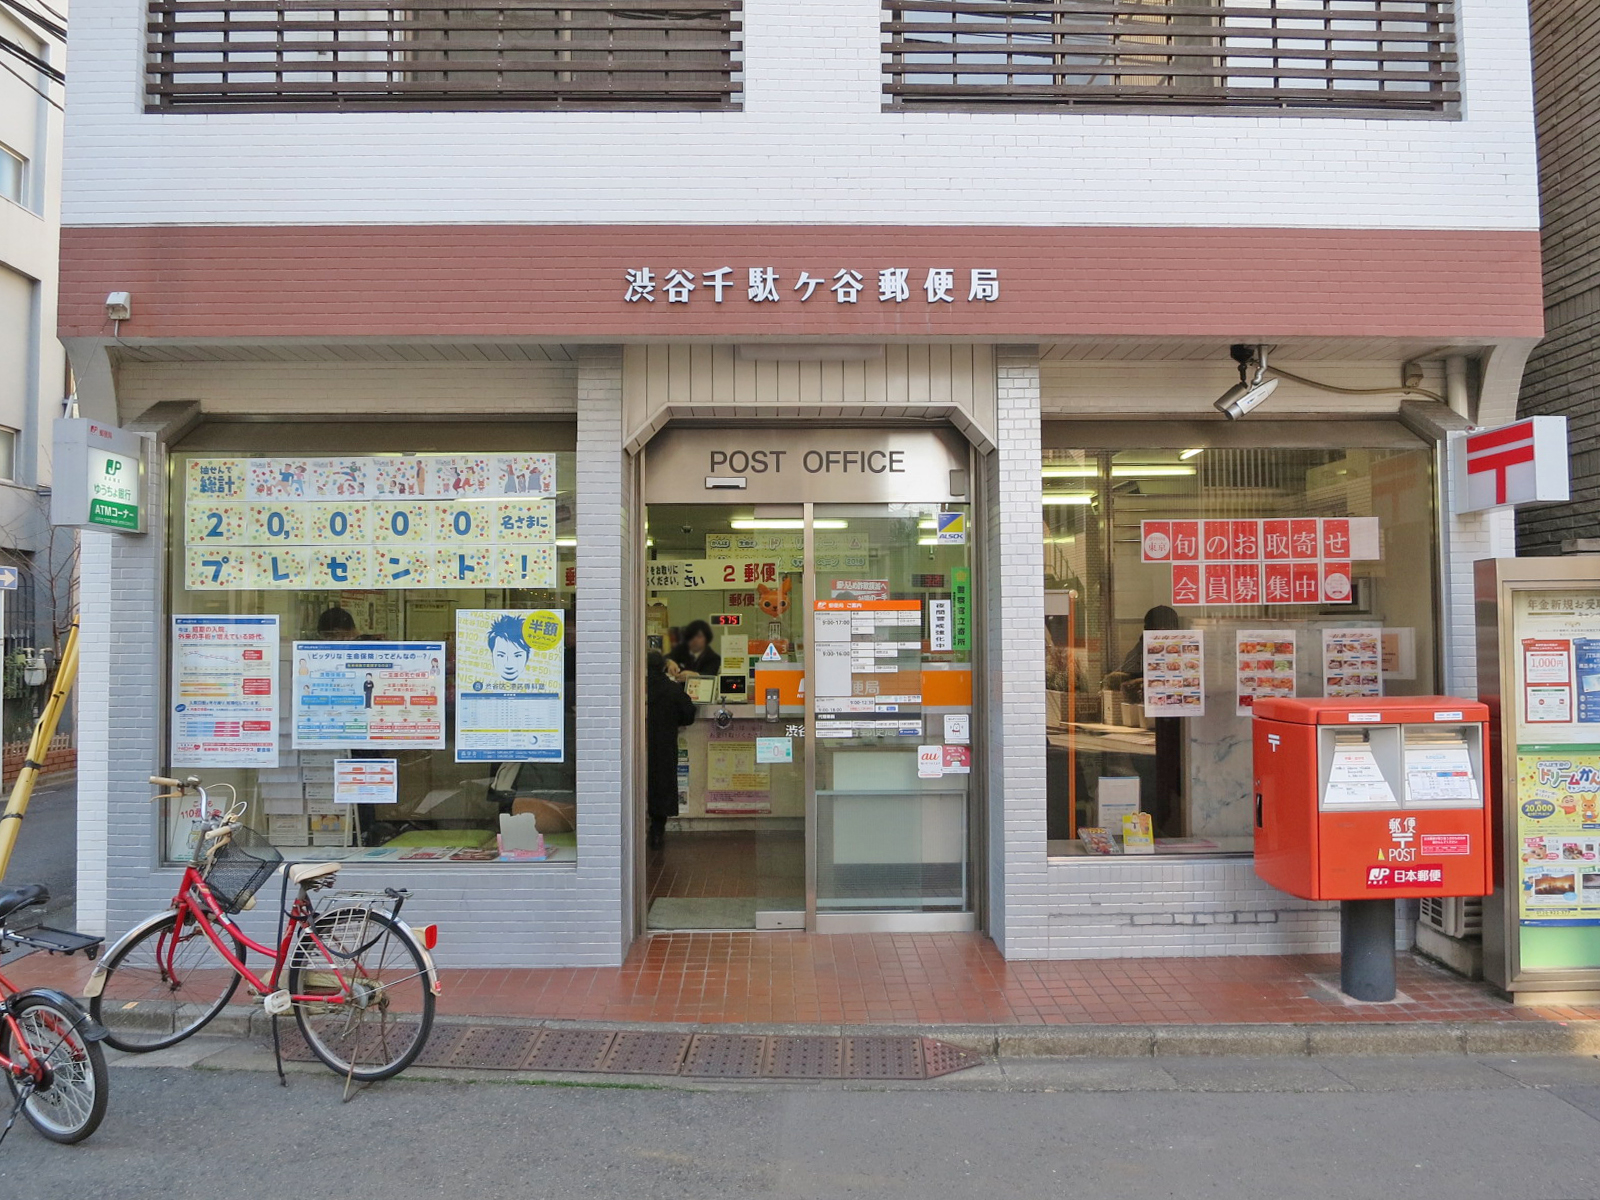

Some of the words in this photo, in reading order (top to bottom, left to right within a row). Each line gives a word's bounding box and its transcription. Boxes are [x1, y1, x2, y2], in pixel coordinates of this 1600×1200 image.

[710, 450, 787, 473] POST
[803, 450, 905, 473] OFFICE
[200, 476, 235, 493] 総計
[94, 484, 131, 501] ゆうちょ銀行
[95, 504, 134, 518] ATMコーナー
[501, 515, 548, 529] 名さまに
[1175, 532, 1347, 556] 旬のお取寄せ
[647, 565, 678, 575] をお取りに
[744, 563, 776, 582] 郵便
[1175, 576, 1317, 600] 会員募集中
[729, 594, 755, 606] 郵便
[529, 619, 558, 636] 半額
[527, 633, 556, 642] キャンペーン
[1525, 805, 1552, 813] 20,000
[1389, 817, 1416, 833] 郵便
[1389, 848, 1416, 861] POST
[1395, 870, 1441, 882] 日本郵便
